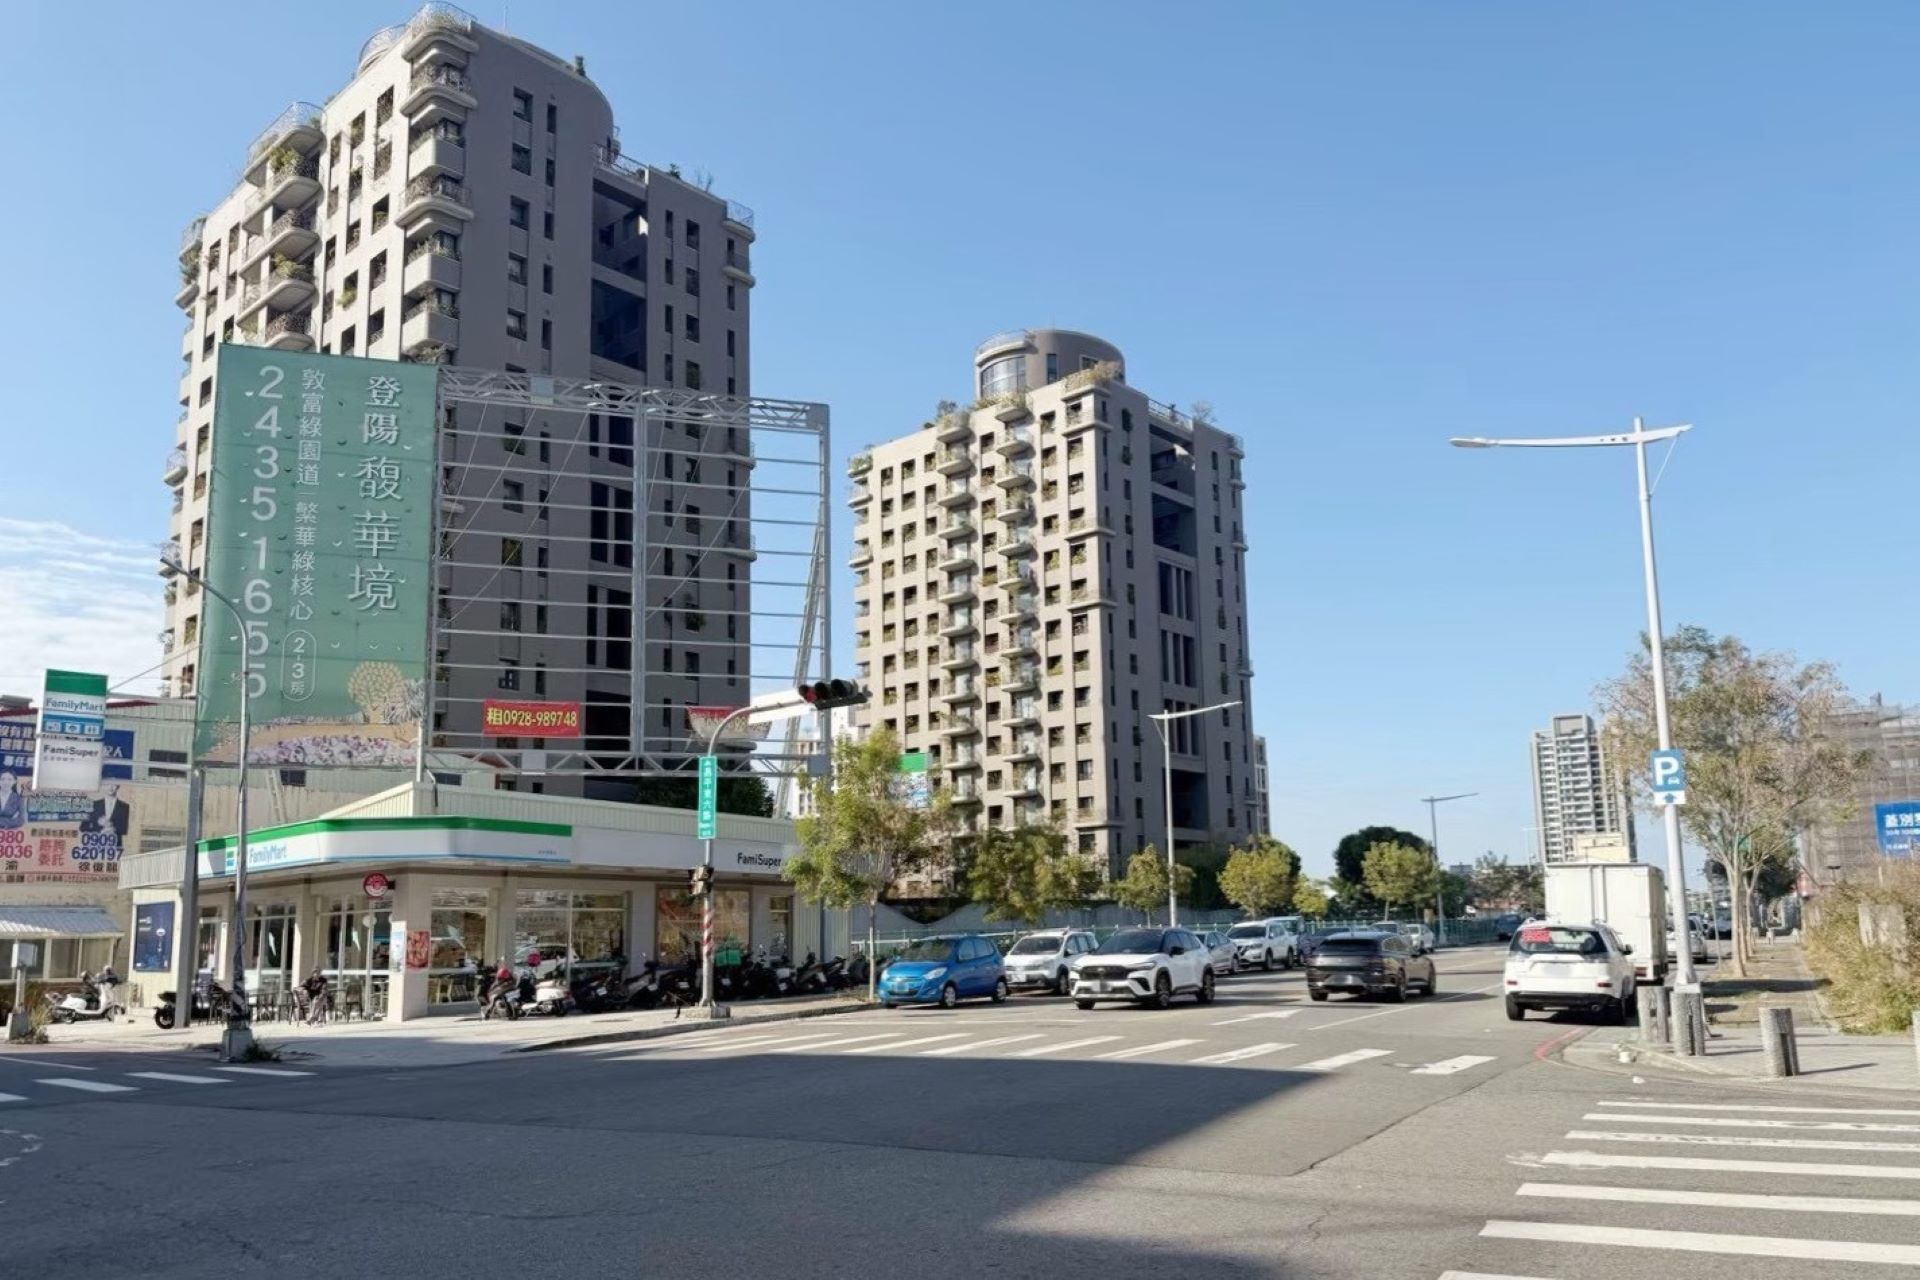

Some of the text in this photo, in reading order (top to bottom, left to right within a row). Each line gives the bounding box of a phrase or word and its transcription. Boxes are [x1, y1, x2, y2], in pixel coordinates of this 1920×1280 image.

[290, 368, 326, 621] 敦富綠園道 繁華綠核心
[46, 697, 104, 712] FamilyMart
[43, 744, 99, 758] FamiSuper
[1654, 756, 1679, 786] P
[81, 833, 117, 847] 0909
[71, 846, 125, 861] 620197
[249, 844, 288, 864] FamilyMart
[737, 851, 782, 869] FamiSuper
